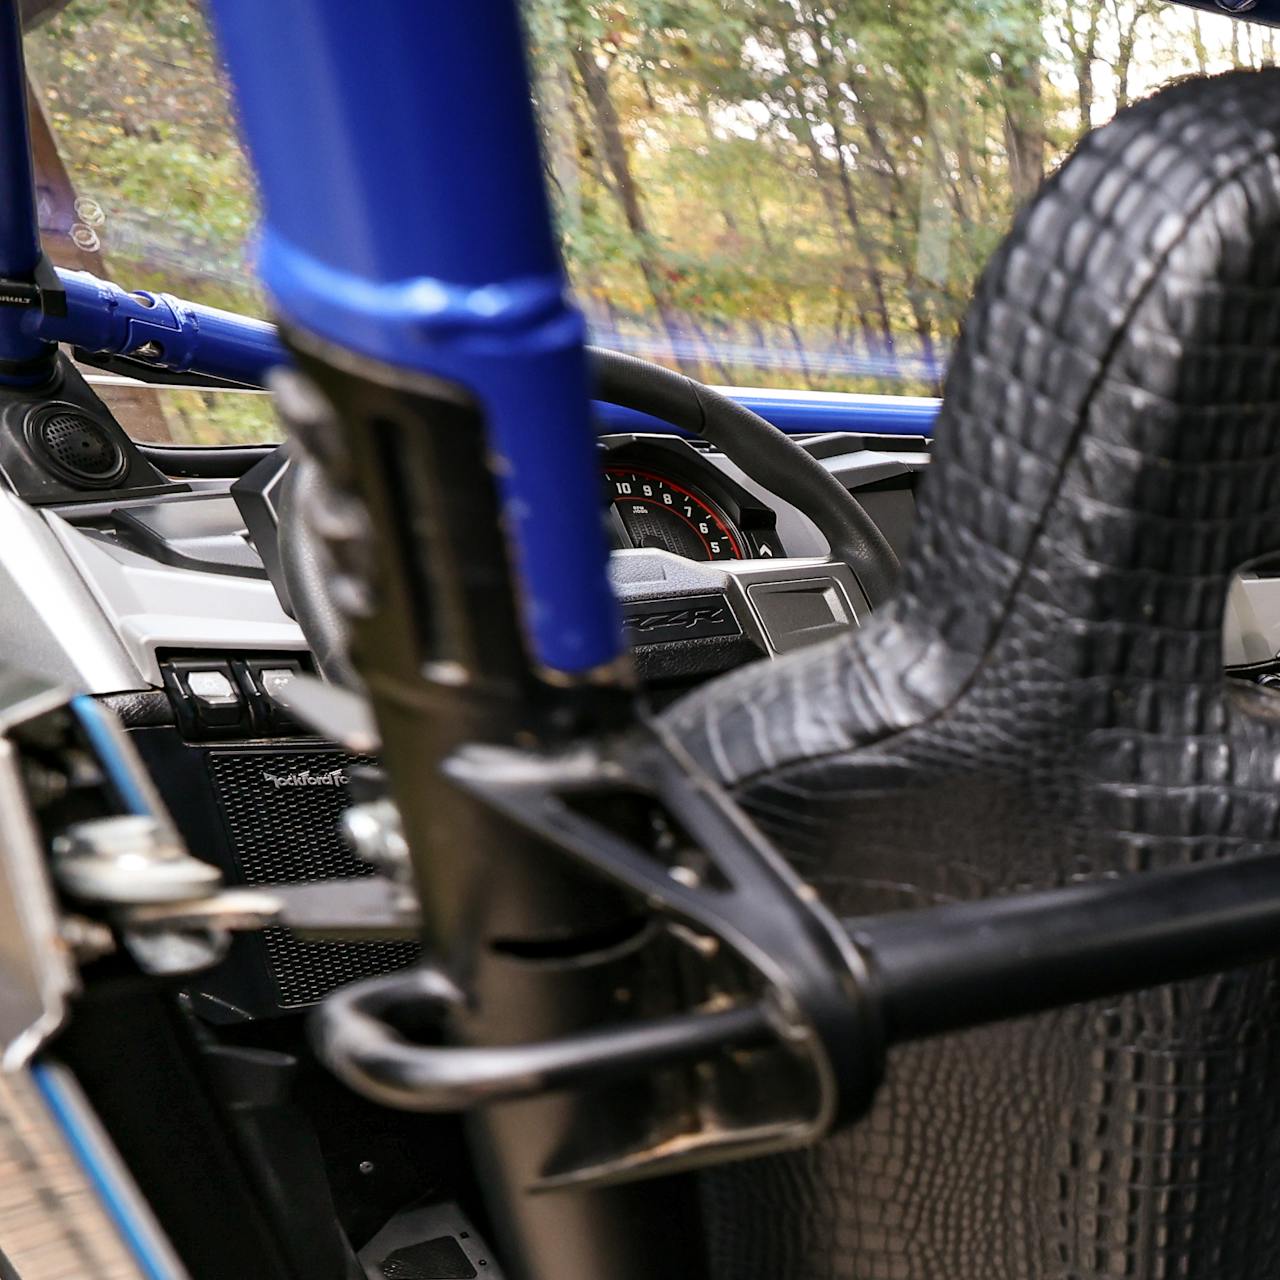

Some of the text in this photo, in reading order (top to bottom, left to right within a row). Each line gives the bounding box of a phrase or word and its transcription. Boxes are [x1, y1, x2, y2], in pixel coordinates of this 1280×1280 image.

[616, 482, 631, 494] 10
[643, 485, 652, 496] 9
[663, 494, 672, 504] 8
[684, 506, 691, 517] 7
[700, 522, 708, 534] 6
[711, 542, 720, 553] 5
